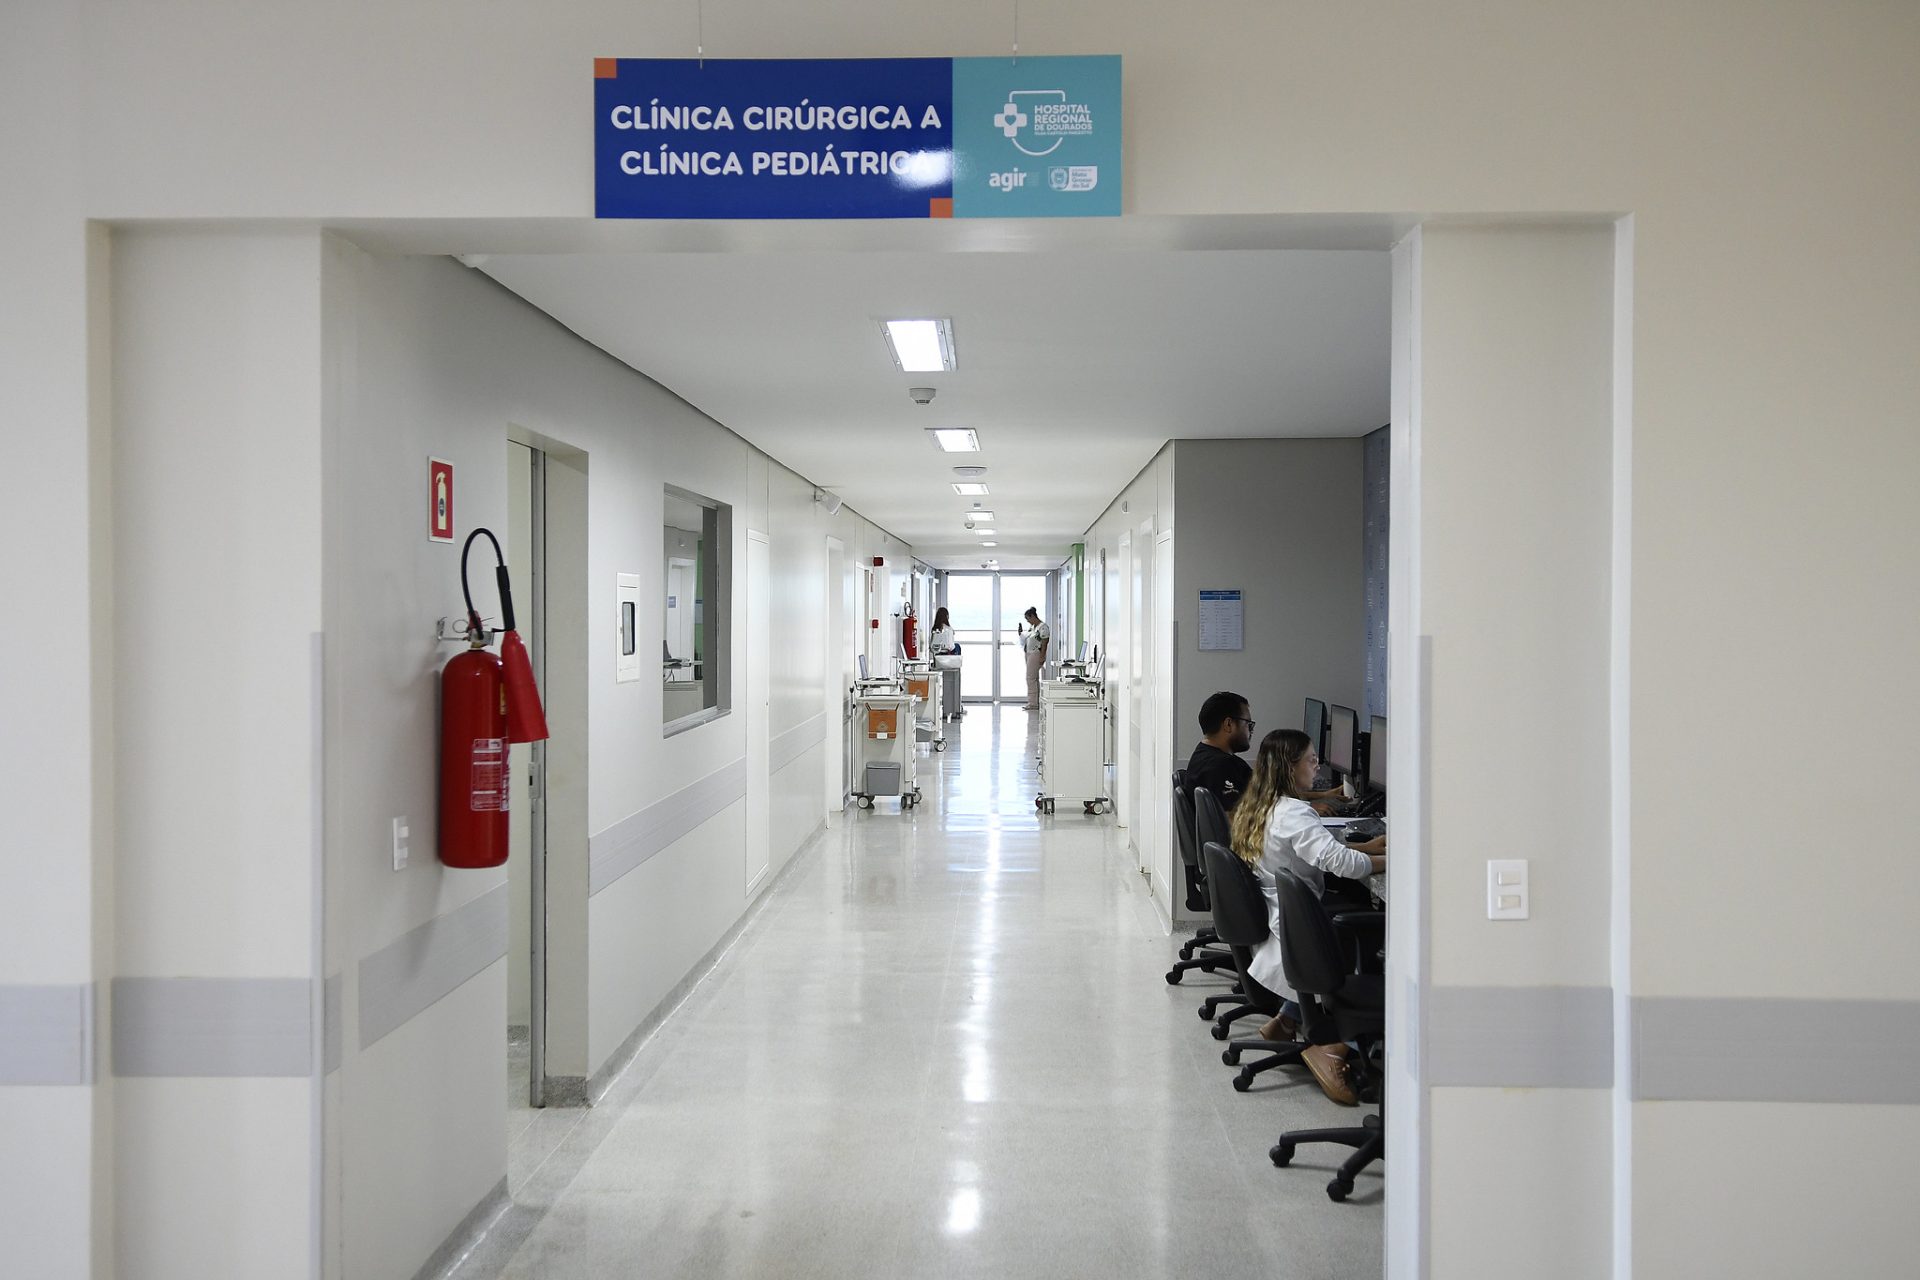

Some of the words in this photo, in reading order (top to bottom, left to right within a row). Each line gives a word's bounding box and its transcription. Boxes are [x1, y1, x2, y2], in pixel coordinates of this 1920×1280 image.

[611, 98, 734, 130] CLÍNICA
[743, 98, 912, 130] CIRÚRGICA
[920, 105, 942, 130] A
[1034, 104, 1091, 114] HOSPITAL
[1034, 114, 1093, 124] REGIONAL
[1046, 123, 1092, 131] DOURADOS
[620, 143, 743, 176] CLÍNICA
[989, 168, 1027, 192] agir
